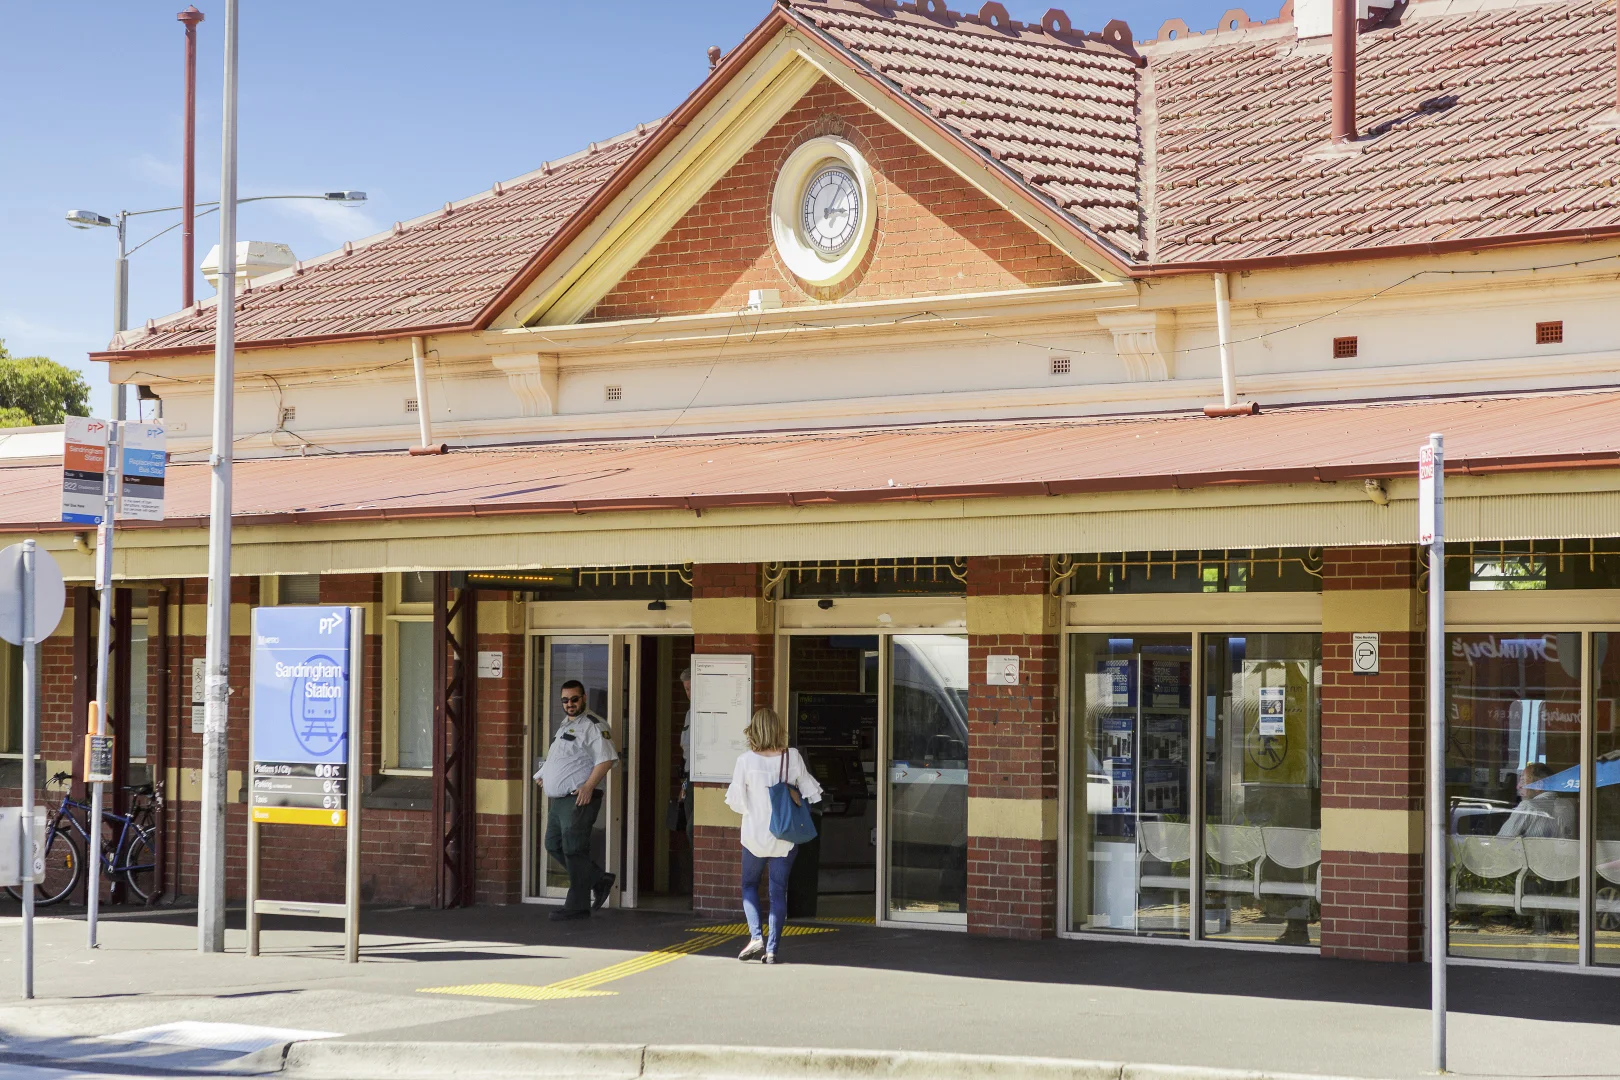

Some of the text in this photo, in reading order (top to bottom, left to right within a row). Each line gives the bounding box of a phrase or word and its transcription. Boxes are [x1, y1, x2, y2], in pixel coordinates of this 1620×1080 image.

[69, 446, 104, 455] Sandringham
[1421, 448, 1433, 463] BUS
[84, 454, 103, 462] Station
[128, 458, 165, 467] Replacement
[150, 467, 164, 475] Stop
[1421, 464, 1434, 479] ZONE
[275, 661, 342, 681] Sandringham
[305, 682, 341, 699] Station
[254, 764, 274, 773] Platform
[281, 765, 292, 776] City
[254, 780, 273, 790] Parking
[255, 795, 268, 804] Taxis
